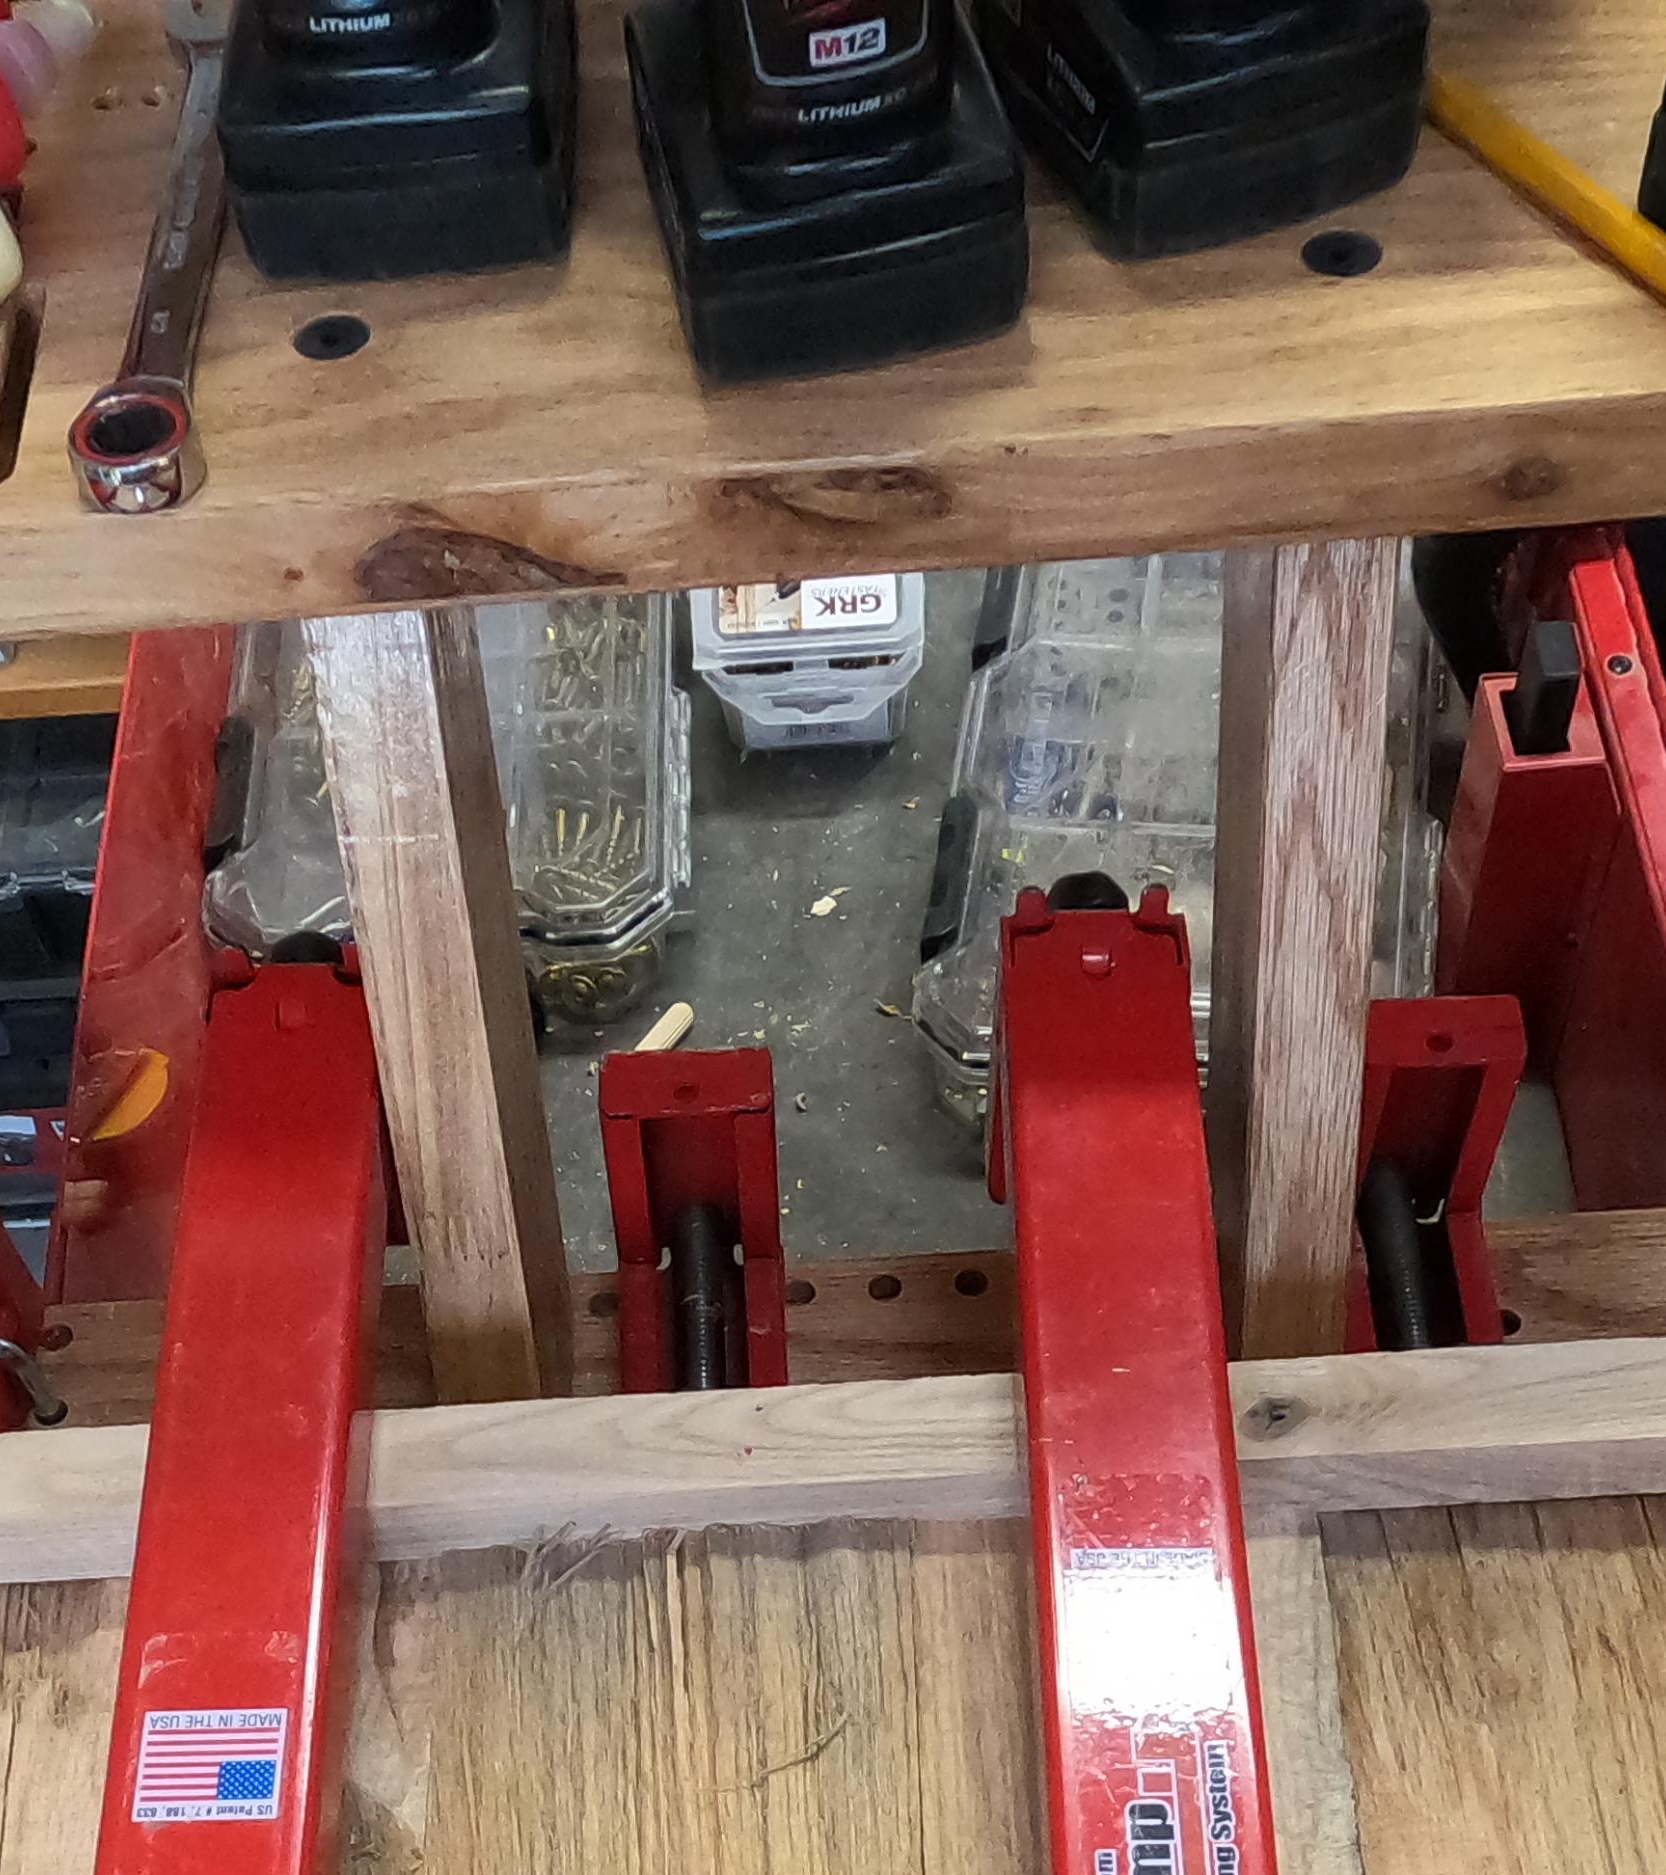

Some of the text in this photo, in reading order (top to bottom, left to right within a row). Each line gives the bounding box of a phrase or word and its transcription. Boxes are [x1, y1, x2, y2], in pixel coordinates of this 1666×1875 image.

[309, 12, 390, 33] LITHIUM
[815, 27, 881, 60] M12
[798, 96, 882, 123] LITHIUM
[813, 593, 881, 618] GRK
[149, 1713, 283, 1729] MADE IN THE USA
[1206, 1743, 1232, 1841] System
